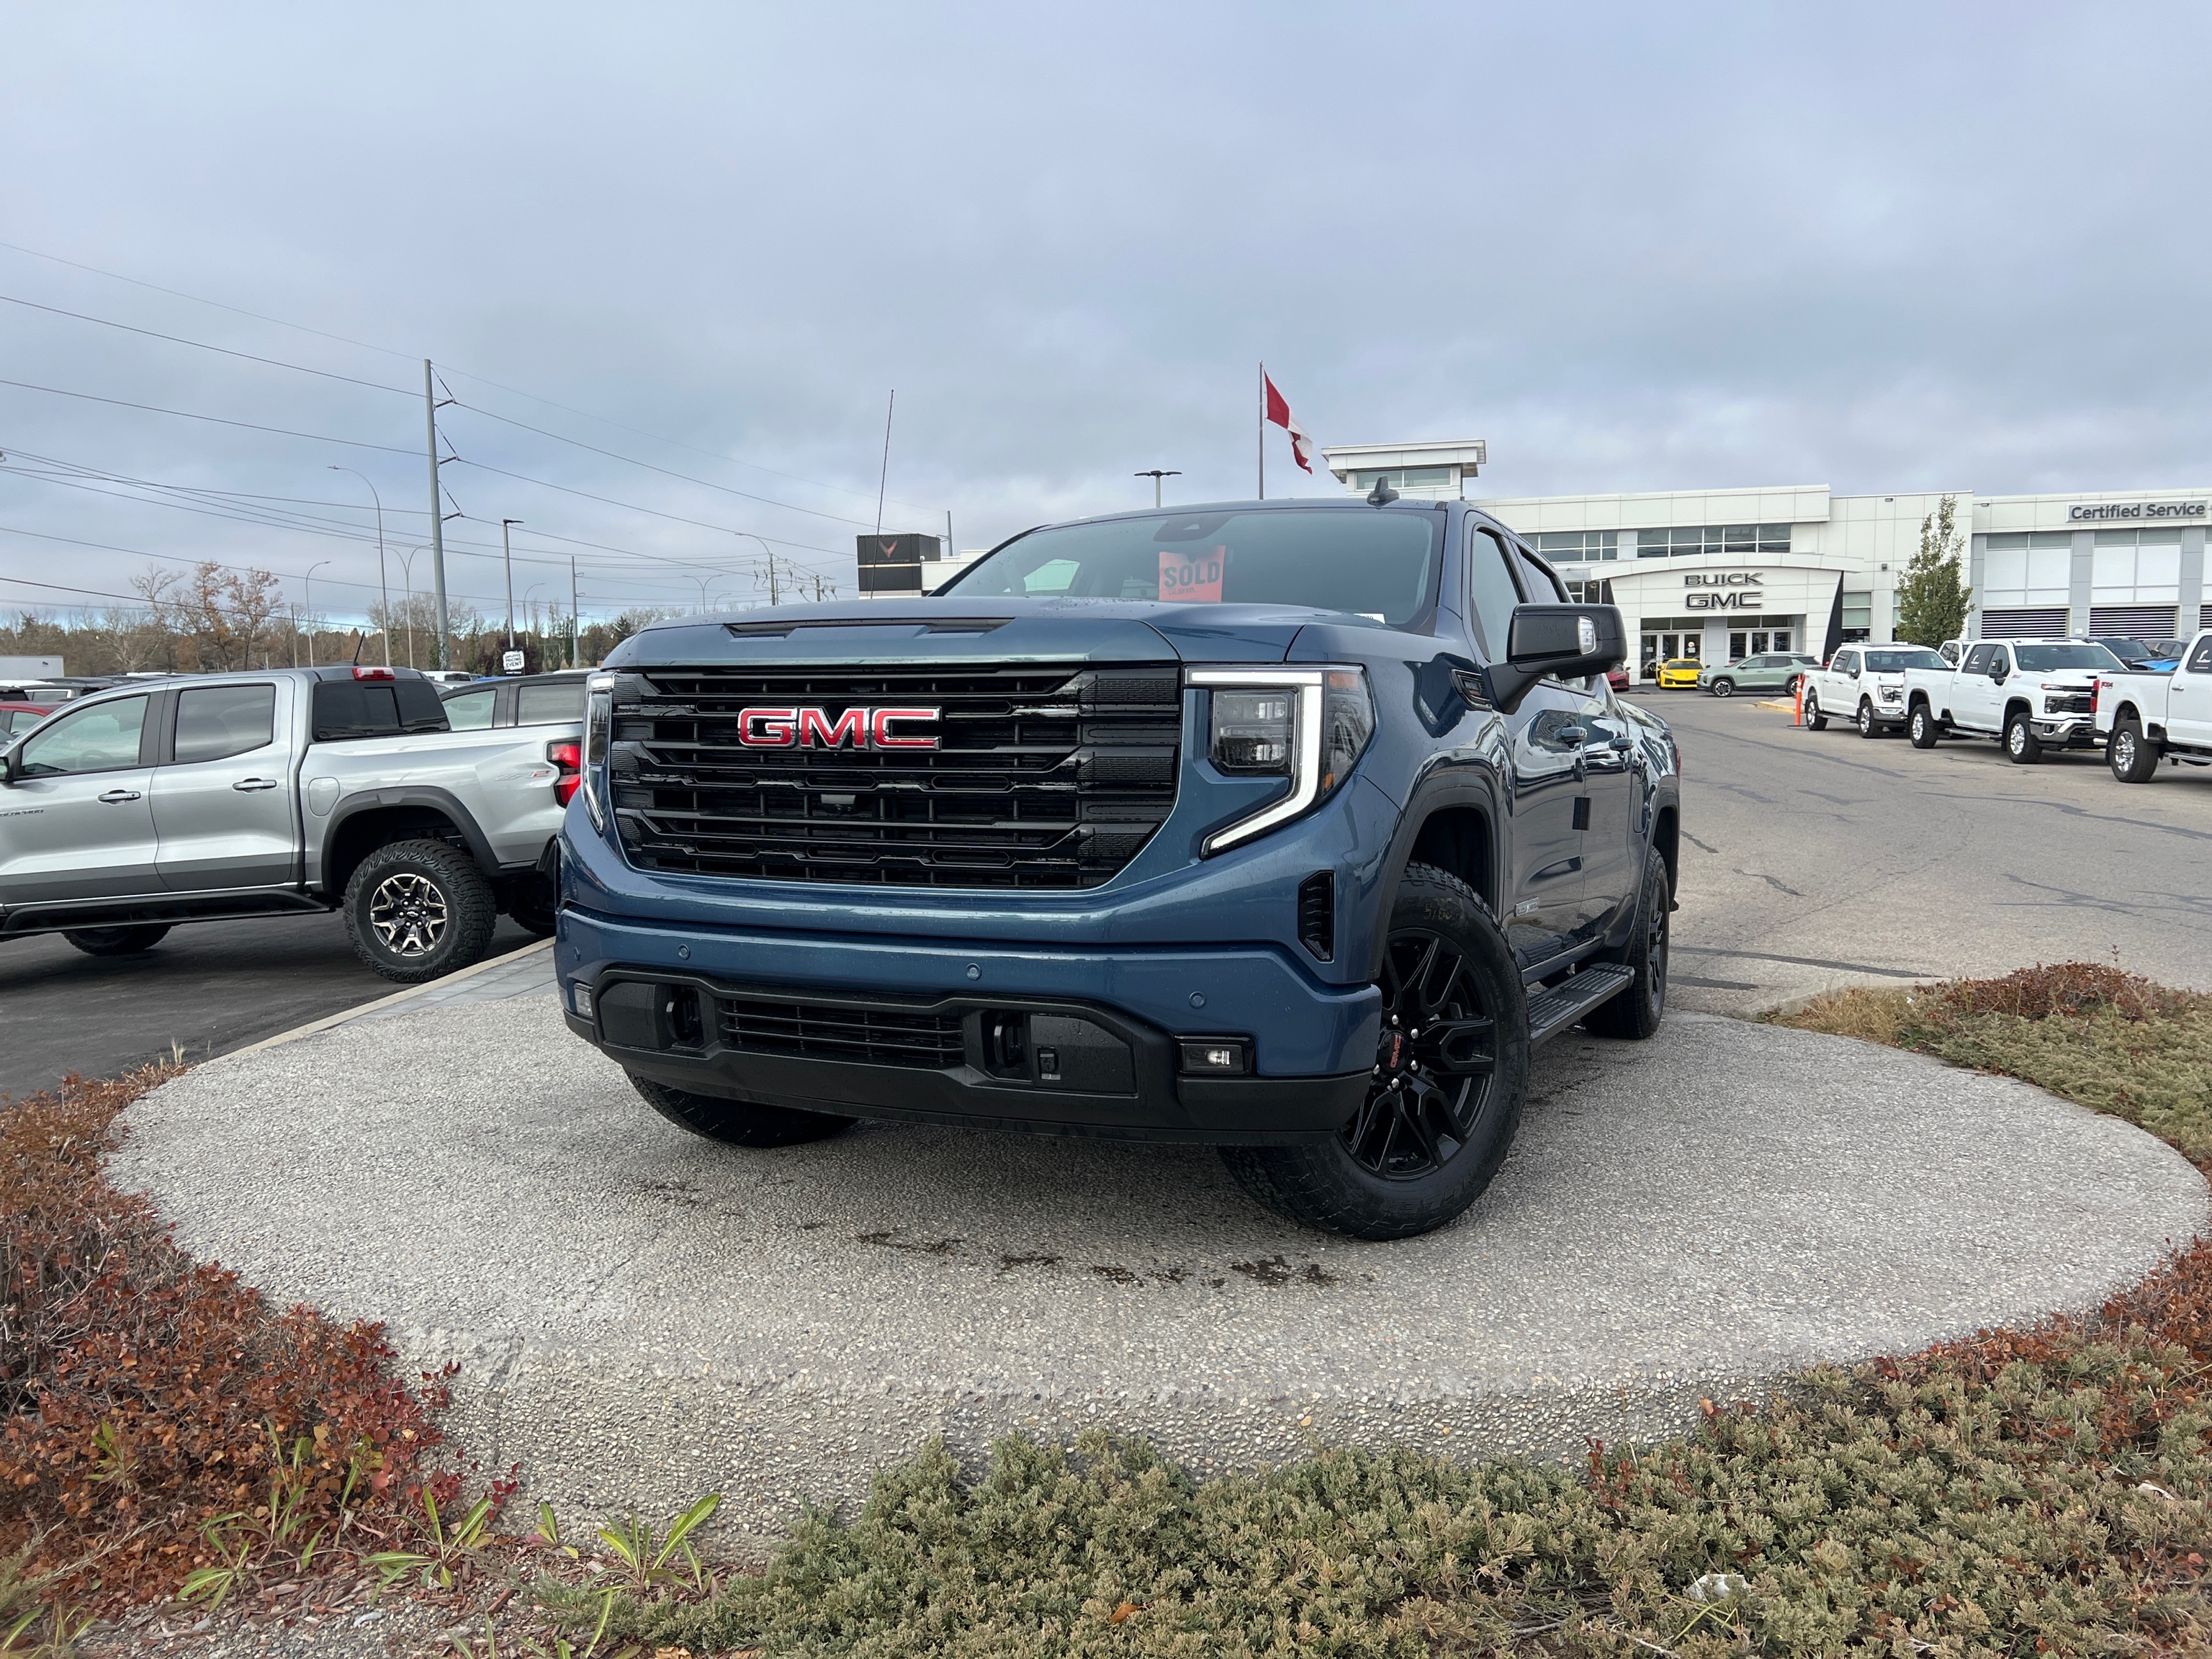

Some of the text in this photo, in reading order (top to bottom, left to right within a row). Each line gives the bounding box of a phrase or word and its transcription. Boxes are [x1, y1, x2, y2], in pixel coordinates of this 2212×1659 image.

[2071, 503, 2206, 519] Certified Service
[1164, 562, 1220, 588] SOLD
[1684, 572, 1763, 587] BUICK
[1686, 591, 1763, 610] GMC
[737, 705, 942, 750] GMC
[1390, 1034, 1402, 1068] GMC
